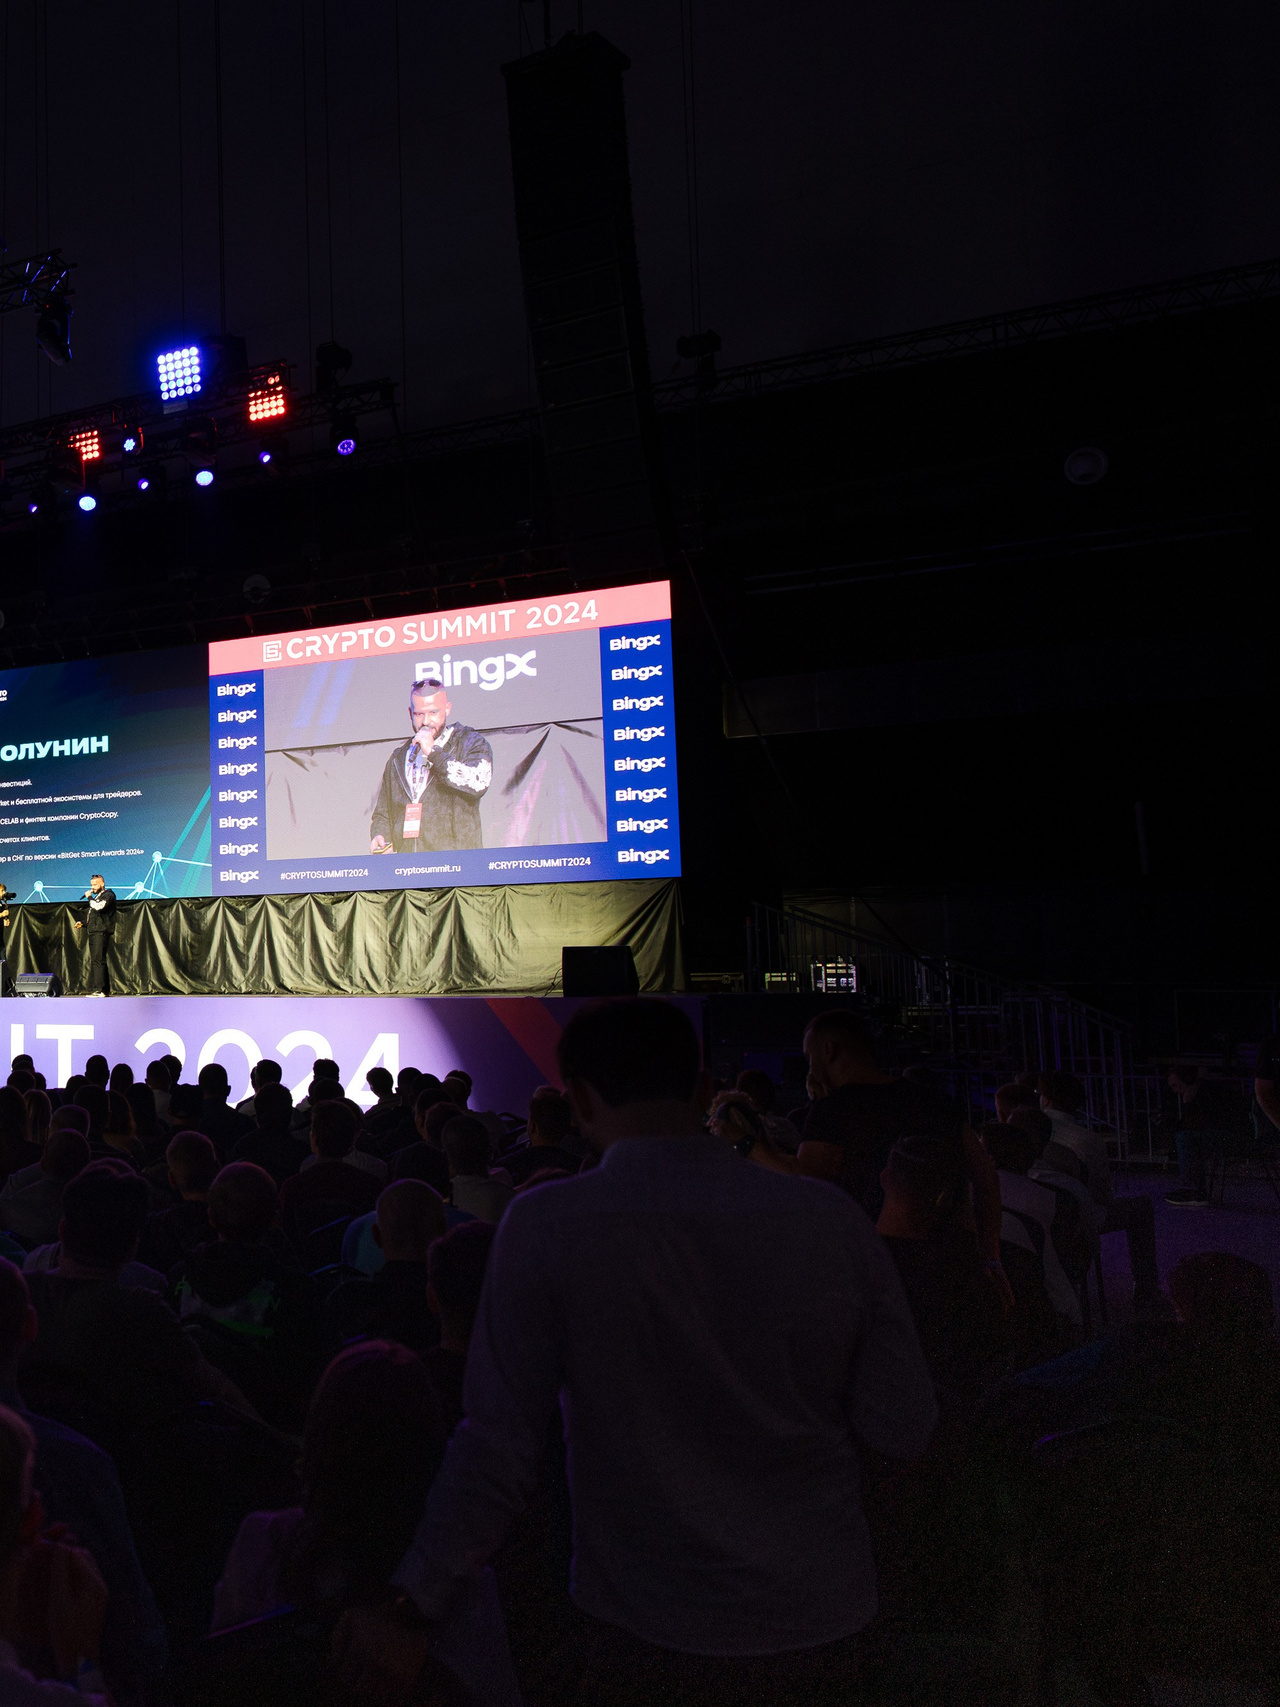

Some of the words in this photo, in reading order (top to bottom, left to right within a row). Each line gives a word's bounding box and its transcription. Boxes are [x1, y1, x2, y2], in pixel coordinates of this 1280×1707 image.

[286, 626, 395, 659] CRYPTO
[402, 609, 516, 645] SUMMIT
[526, 600, 598, 629] 2024
[395, 863, 461, 877] cryptosummit.ru
[489, 857, 591, 872] #CRYPTOSUMMIT2024
[280, 868, 368, 881] #CRYPTOSUMMIT2024
